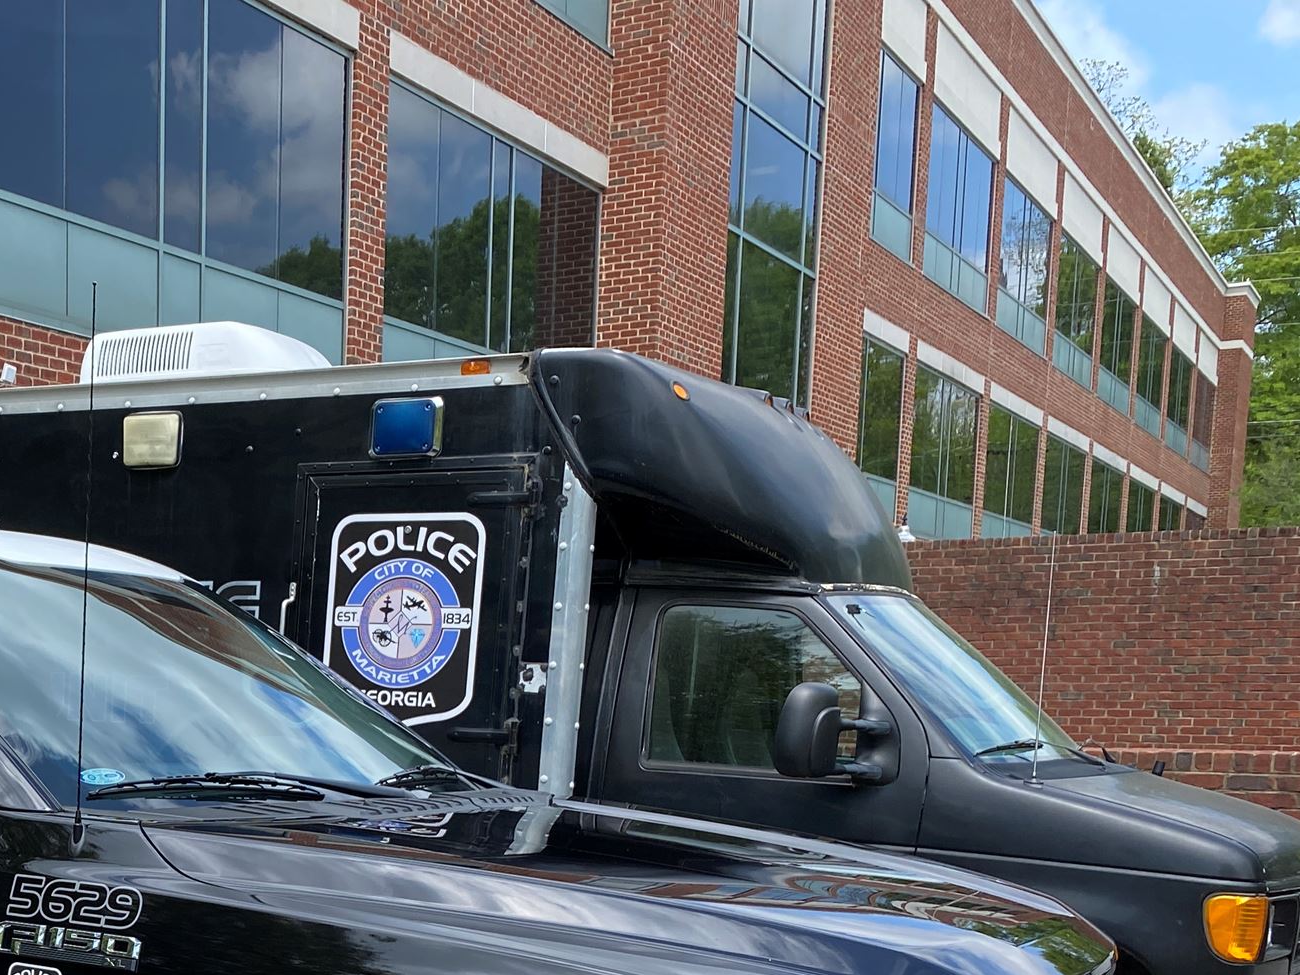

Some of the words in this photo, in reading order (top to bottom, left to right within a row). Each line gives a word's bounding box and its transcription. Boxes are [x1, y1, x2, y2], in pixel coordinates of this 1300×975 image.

[339, 526, 477, 574] POLICE
[374, 561, 407, 581] CITY
[411, 562, 436, 581] OF
[443, 612, 471, 625] 1834
[351, 648, 446, 685] MARIETTA
[361, 689, 436, 708] EORGIA
[6, 874, 143, 929] 5629
[104, 957, 126, 968] XL
